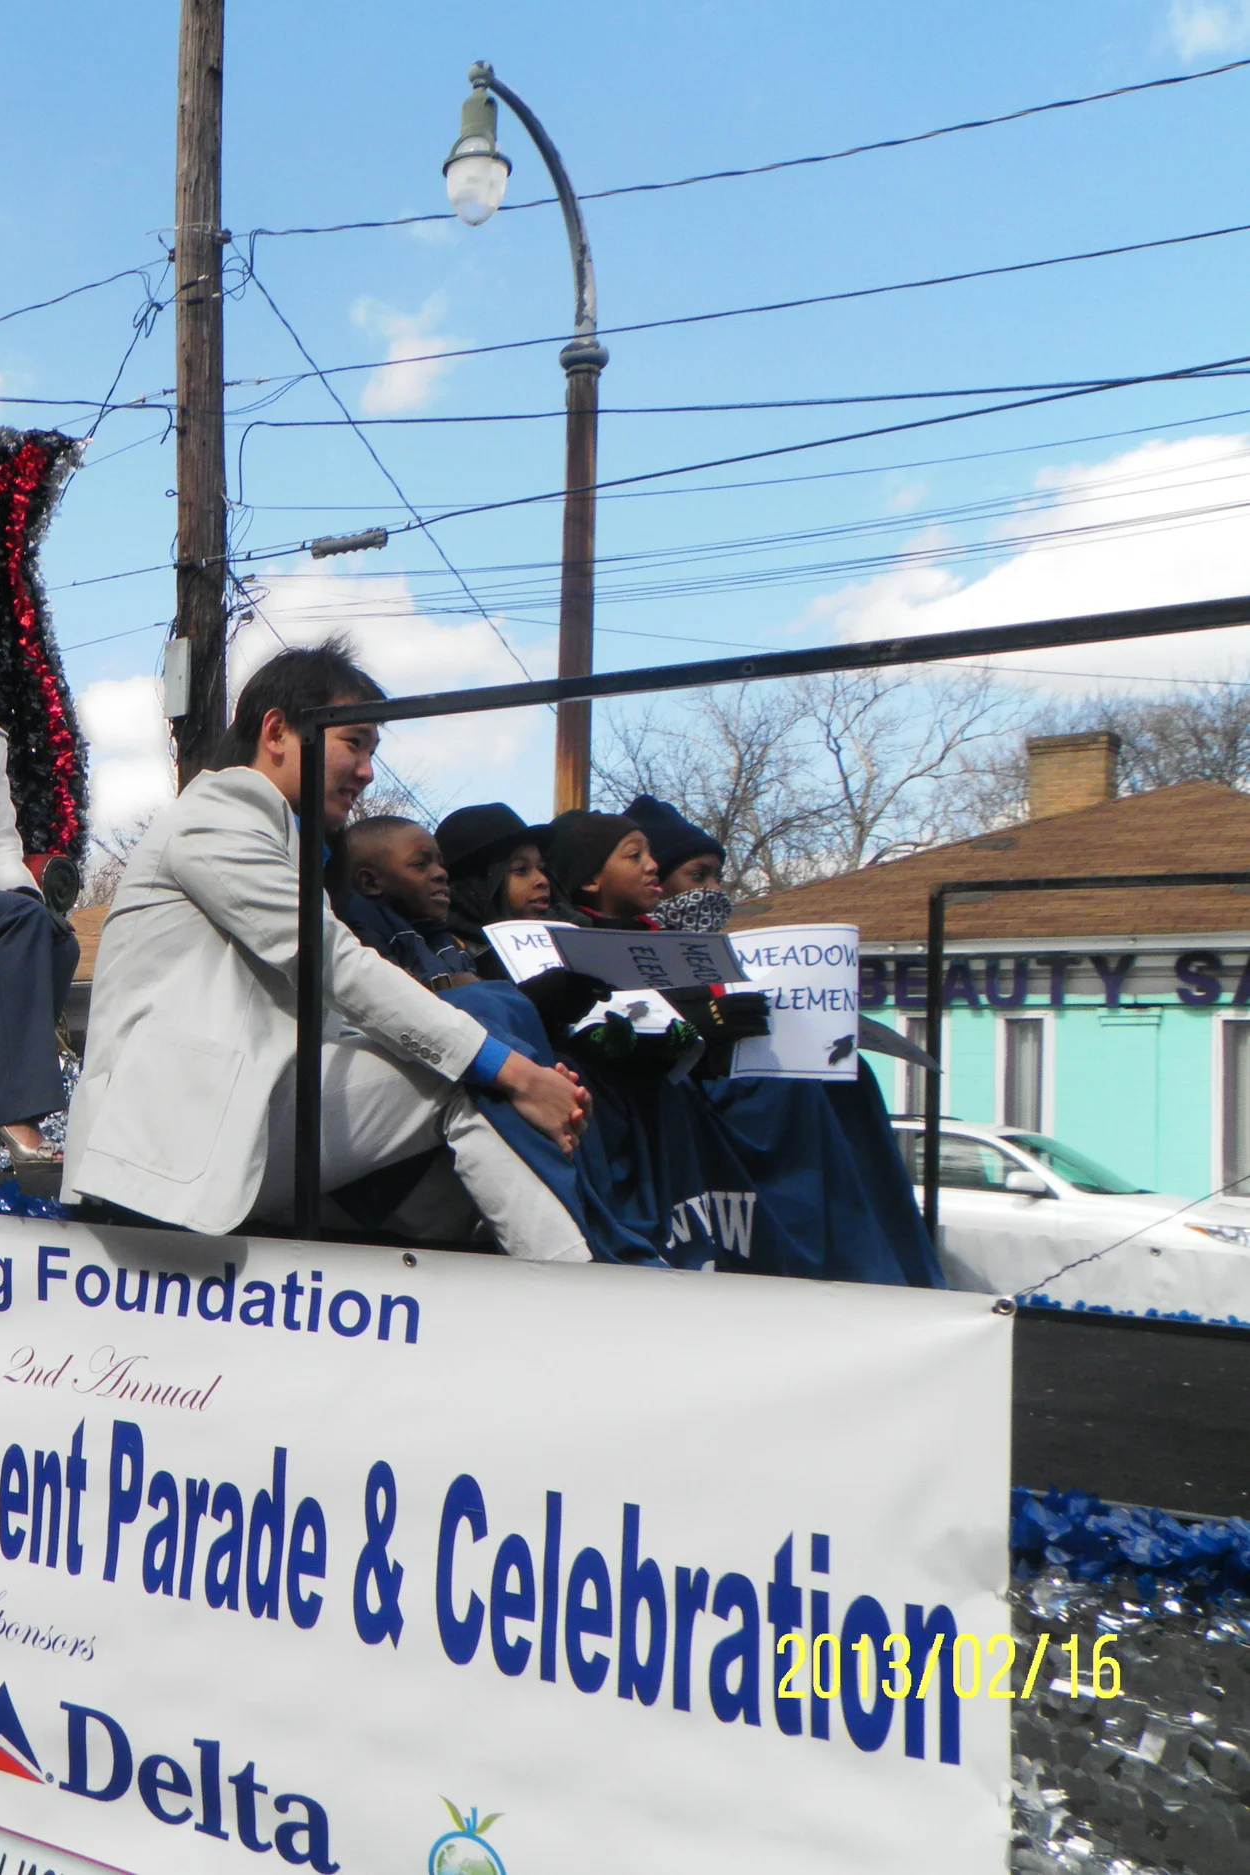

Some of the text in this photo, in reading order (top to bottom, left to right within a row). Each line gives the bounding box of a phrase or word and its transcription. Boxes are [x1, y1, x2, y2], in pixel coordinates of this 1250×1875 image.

[859, 953, 1136, 1009] BEAUTY
[37, 1245, 420, 1344] Foundation
[1, 1345, 74, 1389] 2nd
[72, 1345, 222, 1412] Annual
[103, 1419, 327, 1629] Parade
[353, 1460, 404, 1650] &
[436, 1473, 961, 1766] Celebration
[59, 1700, 340, 1875] Delta
